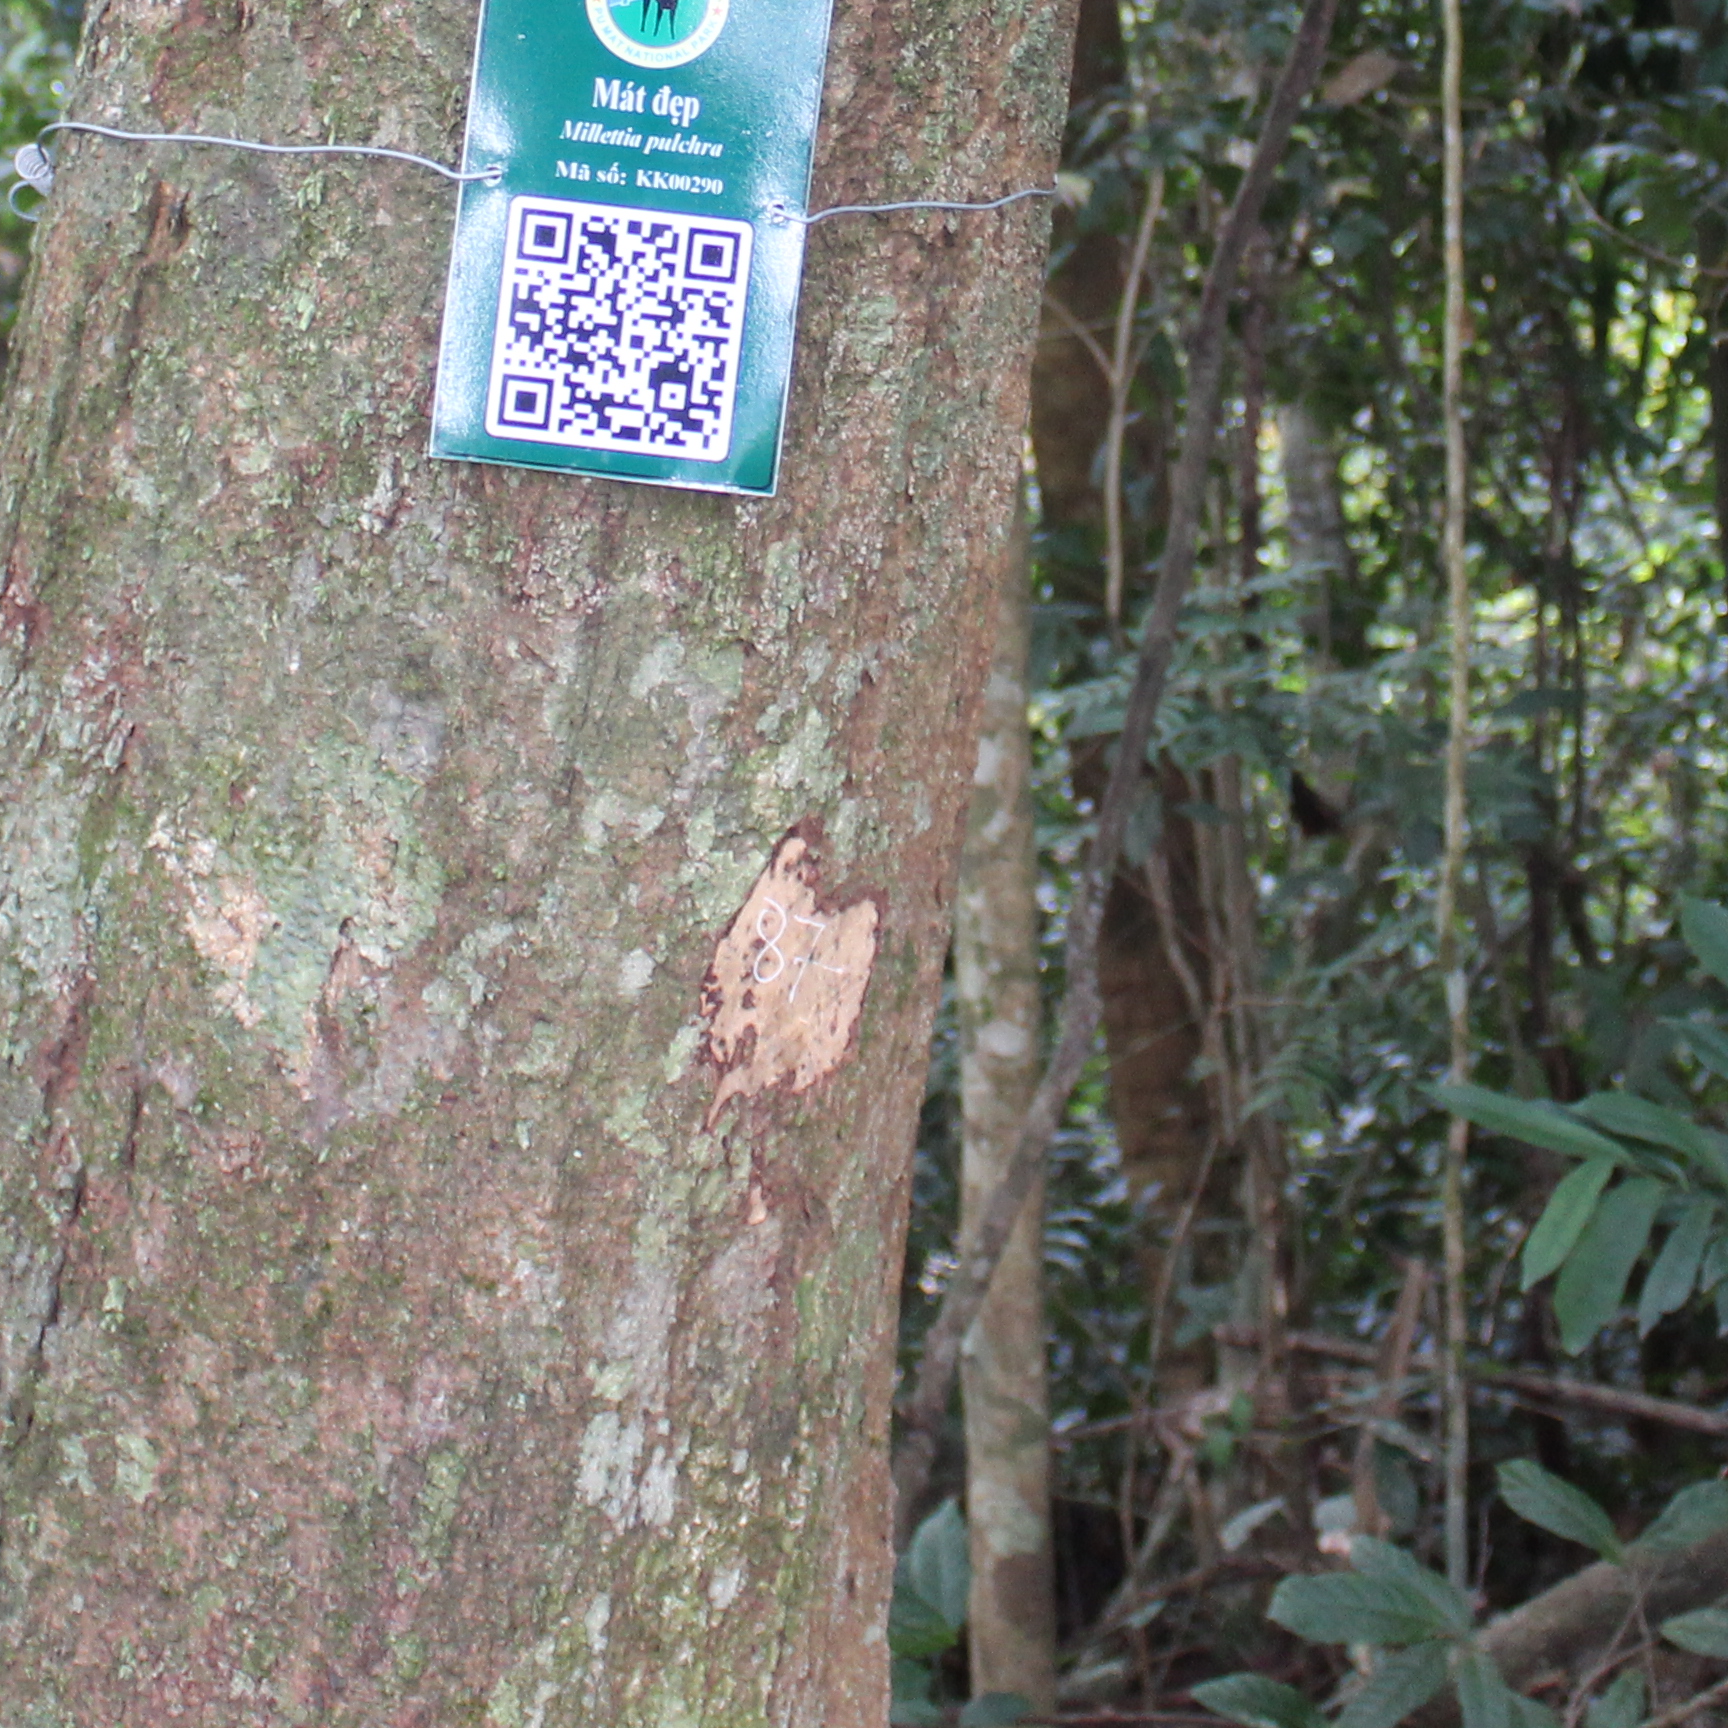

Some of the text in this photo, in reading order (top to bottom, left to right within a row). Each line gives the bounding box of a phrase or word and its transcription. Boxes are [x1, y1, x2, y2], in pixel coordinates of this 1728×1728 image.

[601, 25, 626, 48] MAT
[625, 46, 690, 63] NATIONAL
[690, 20, 718, 50] PARK
[592, 77, 700, 128] Mát đẹp
[559, 120, 723, 158] Millettia pulchra
[555, 160, 724, 196] Mã số: KK00290
[753, 896, 844, 1004] 87
